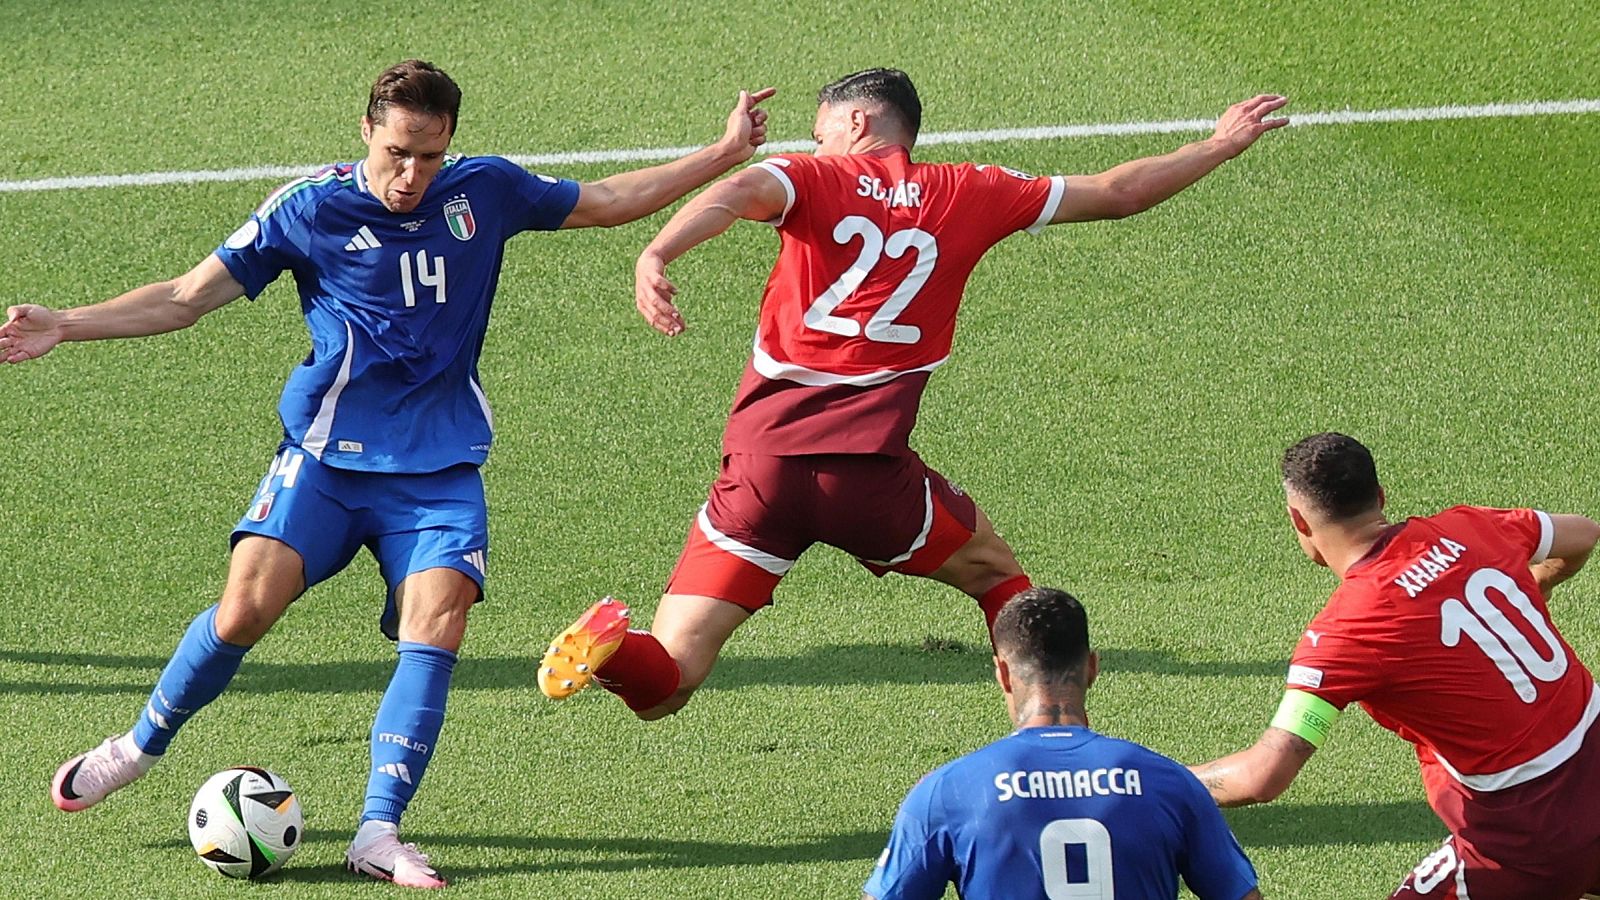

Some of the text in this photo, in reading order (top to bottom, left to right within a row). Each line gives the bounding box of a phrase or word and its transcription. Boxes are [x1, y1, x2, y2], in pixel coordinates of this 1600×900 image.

[446, 202, 468, 215] ITALIA
[400, 249, 447, 307] 14
[803, 215, 938, 344] 22
[1394, 537, 1468, 598] XHAKA
[1440, 567, 1569, 704] 10
[379, 732, 429, 755] ITALIA
[994, 768, 1142, 802] SCAMACCA
[1040, 818, 1115, 900] 9
